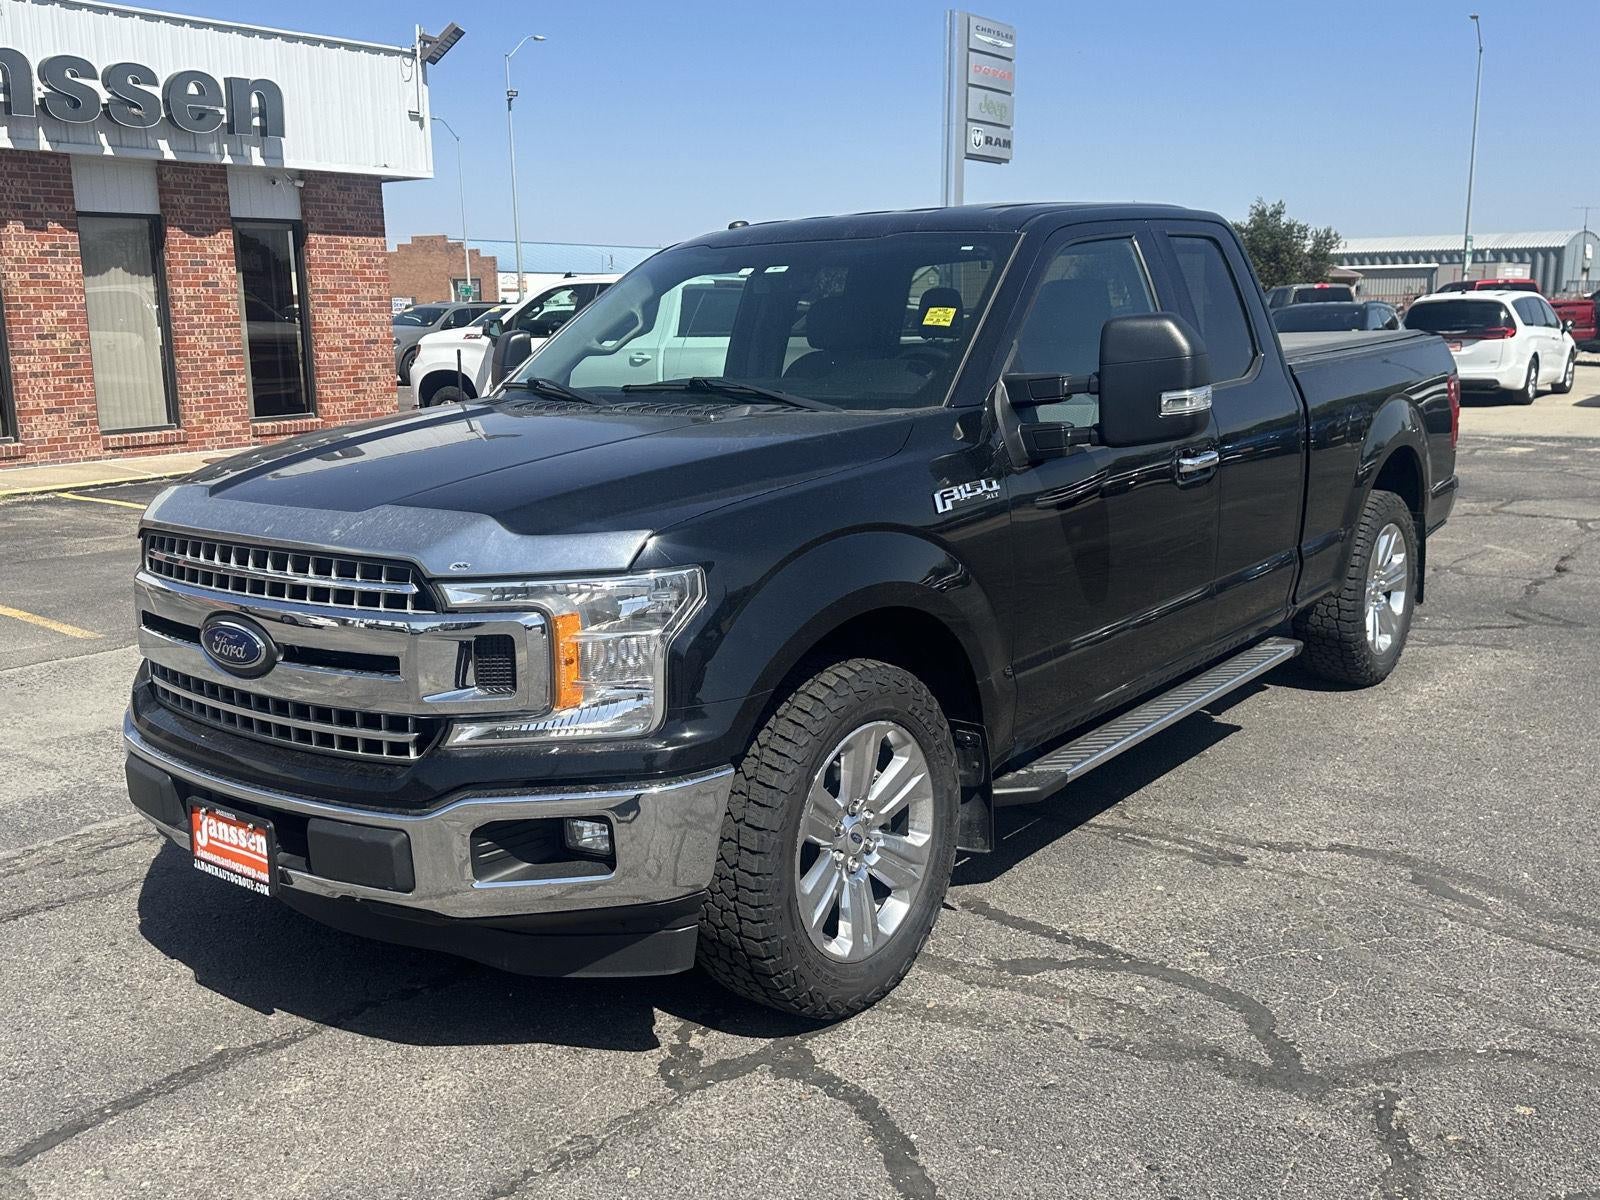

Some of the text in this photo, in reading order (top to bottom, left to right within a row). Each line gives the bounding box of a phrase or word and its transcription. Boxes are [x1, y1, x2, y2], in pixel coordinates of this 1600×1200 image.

[975, 24, 1014, 41] CHRYSLER
[979, 94, 1008, 121] Jeep
[984, 135, 1011, 149] RAM
[986, 491, 999, 500] XLT
[212, 630, 247, 659] Ford
[196, 811, 268, 857] Janssen
